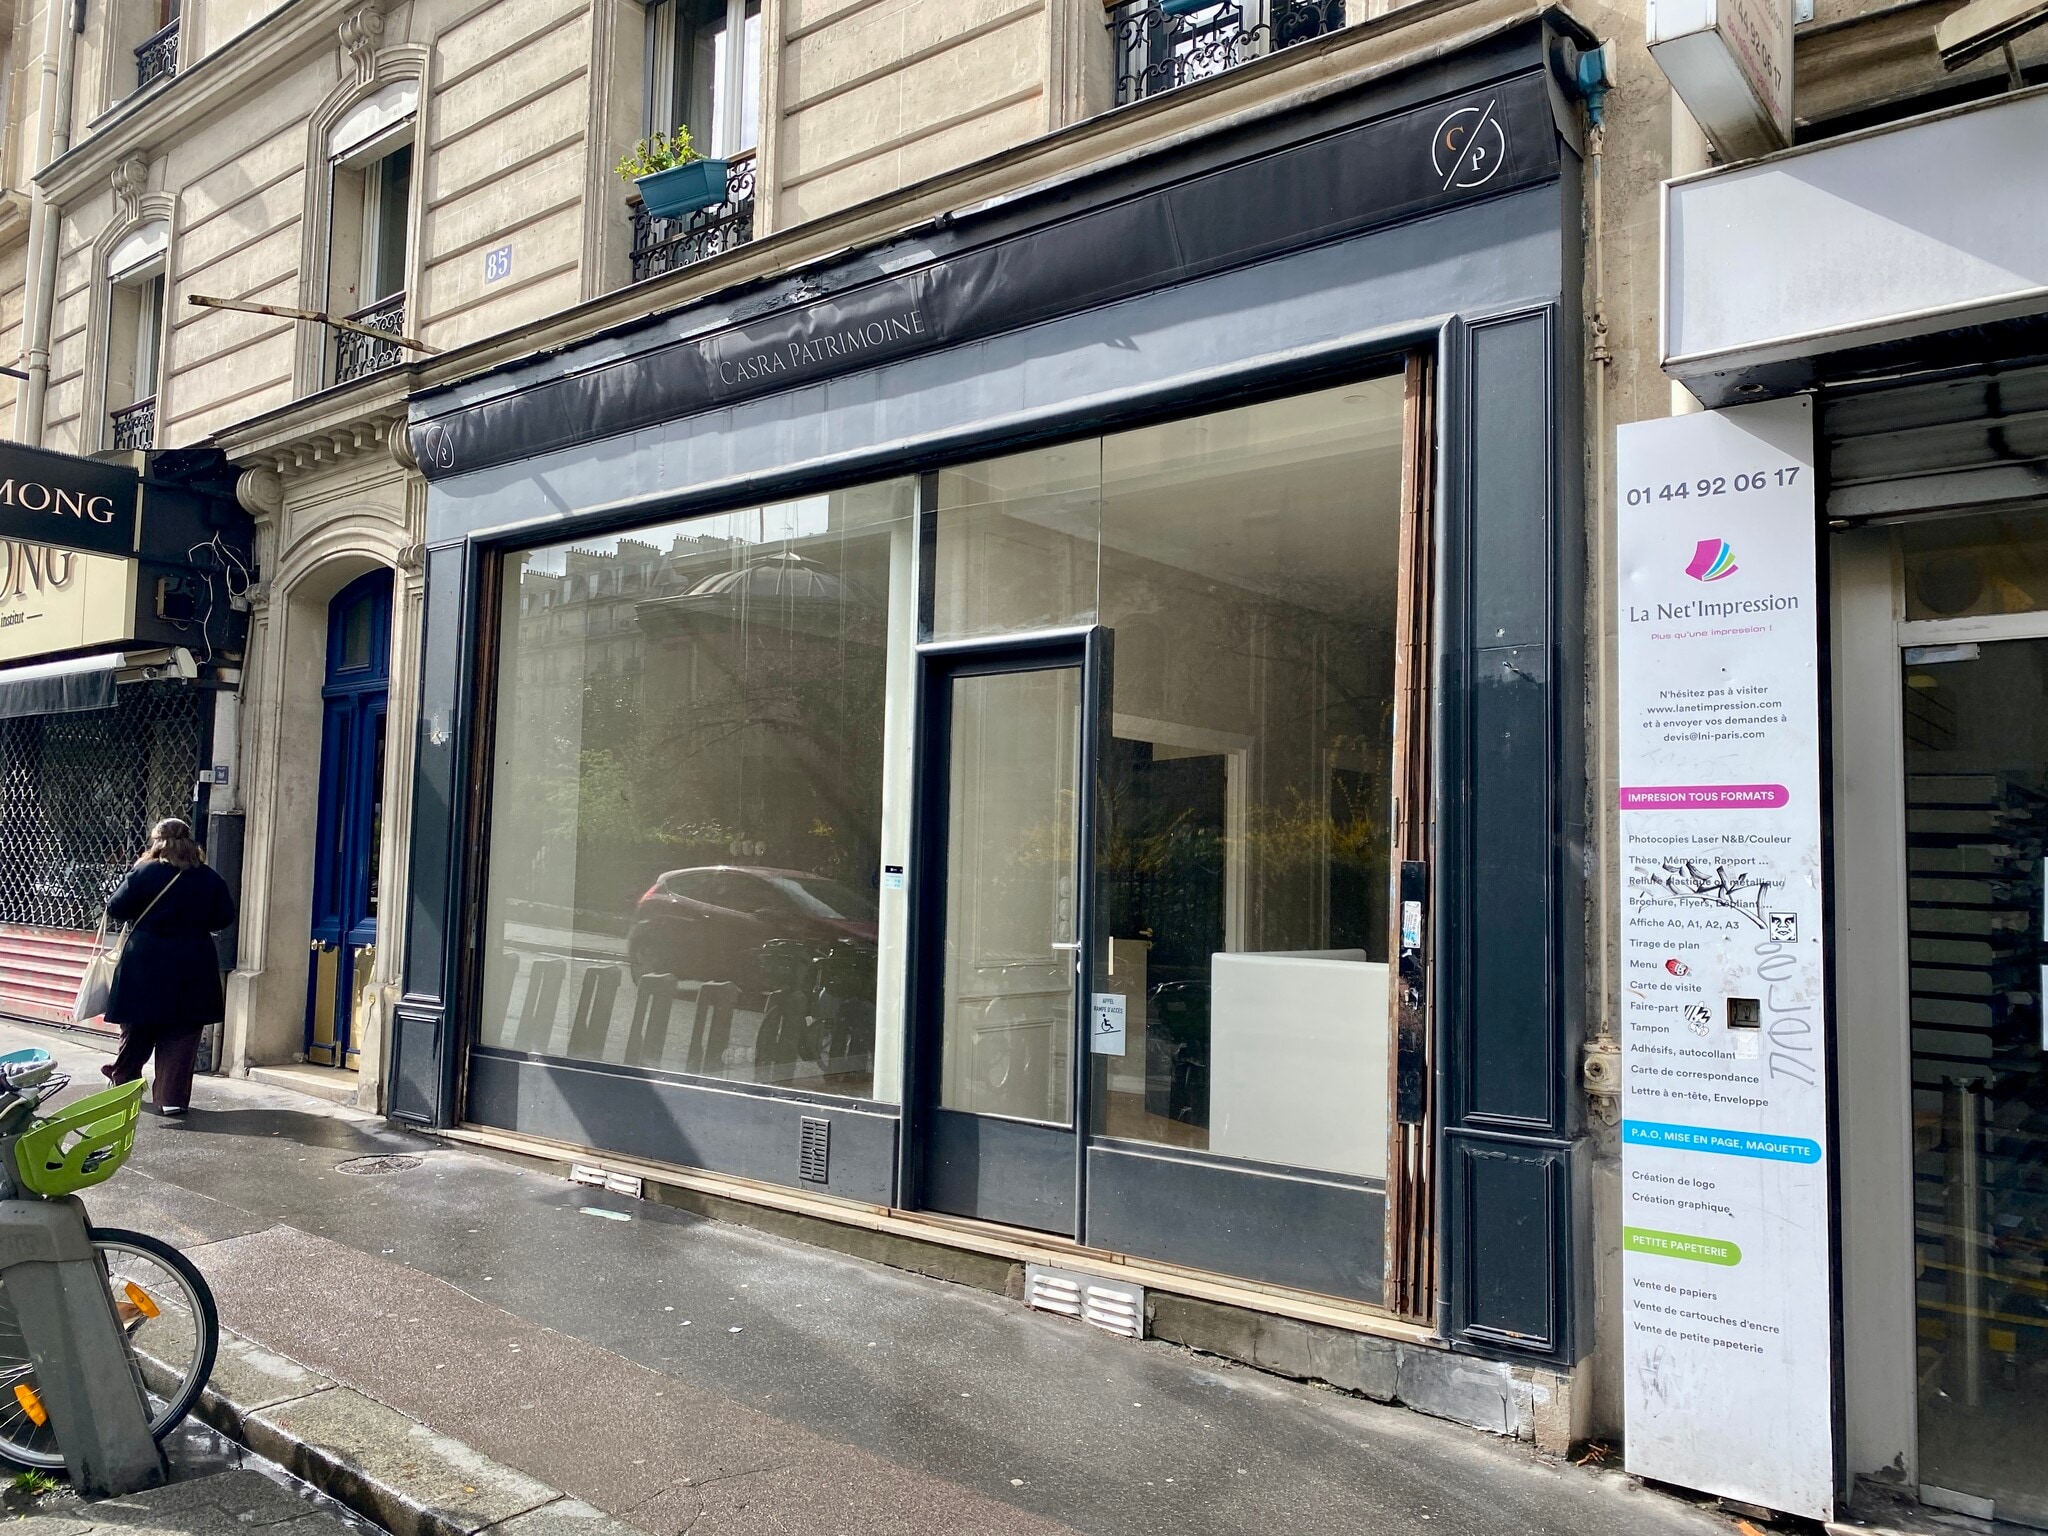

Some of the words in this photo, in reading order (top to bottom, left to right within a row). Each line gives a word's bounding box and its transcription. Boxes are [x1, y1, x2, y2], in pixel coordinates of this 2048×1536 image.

[1750, 22, 1760, 56] 92
[1762, 44, 1772, 77] 06
[1774, 66, 1782, 91] 17
[487, 247, 509, 279] 85
[719, 351, 787, 386] CASRA
[788, 310, 925, 367] PATRIMOINE
[1626, 487, 1650, 506] 01
[1658, 482, 1690, 501] 44
[1696, 476, 1726, 497] 92
[1734, 471, 1766, 492] 06
[1774, 466, 1800, 486] 17
[1630, 606, 1650, 622] La
[1657, 594, 1799, 620] Net'Impression
[1674, 630, 1708, 640] qu'une
[1711, 625, 1766, 636] impression
[1660, 690, 1704, 699] N'hésitez
[1708, 688, 1725, 698] pas
[1728, 686, 1734, 696] à
[1736, 686, 1768, 694] visiter
[1647, 700, 1782, 714] www.lanetimpression.com
[1642, 720, 1652, 728] et
[1655, 718, 1661, 728] à
[1663, 718, 1702, 728] envoyer
[1705, 718, 1722, 726] vos
[1724, 714, 1778, 726] demandes
[1781, 713, 1788, 723] à
[1664, 730, 1765, 742] devis@lni-paris.com
[1628, 793, 1686, 802] IMPRESION
[1689, 792, 1718, 802] TOUS
[1720, 791, 1775, 800] FORMATS
[1628, 835, 1689, 846] Photocopies
[1692, 834, 1718, 844] Laser
[1722, 834, 1792, 844] N&B/Couleur
[1628, 856, 1660, 865] Thèse,
[1664, 856, 1712, 866] Mémoire,
[1630, 898, 1676, 907] Brochure,
[1680, 899, 1712, 908] Flyers,
[1630, 918, 1664, 928] Affiche
[1688, 920, 1702, 930] A1,
[1705, 921, 1722, 930] A2,
[1726, 921, 1740, 930] A3
[1630, 939, 1660, 950] Tirage
[1662, 940, 1676, 949] de
[1678, 941, 1700, 950] plan
[1630, 960, 1658, 970] Menu
[1630, 981, 1658, 991] Carte
[1660, 983, 1672, 992] de
[1675, 984, 1702, 993] visite
[1630, 1002, 1679, 1013] Faire-part
[1630, 1023, 1670, 1034] Tampon
[1630, 1044, 1676, 1056] Adhésifs,
[1631, 1064, 1659, 1076] Carte
[1662, 1068, 1674, 1076] de
[1676, 1069, 1760, 1084] correspondance
[1631, 1086, 1661, 1096] Lettre
[1663, 1088, 1670, 1098] à
[1672, 1090, 1711, 1102] en-tête,
[1714, 1093, 1769, 1107] Enveloppe
[1632, 1128, 1662, 1140] P.A.O,
[1664, 1131, 1690, 1142] MISE
[1694, 1134, 1708, 1144] EN
[1711, 1136, 1742, 1150] PAGE,
[1746, 1140, 1810, 1156] MAQUETTE
[1632, 1170, 1675, 1184] Création
[1678, 1176, 1690, 1186] de
[1693, 1178, 1716, 1190] logo
[1632, 1192, 1675, 1206] Création
[1678, 1199, 1730, 1214] graphique
[1632, 1235, 1668, 1248] PETITE
[1670, 1240, 1728, 1258] PAPETERIE
[1633, 1278, 1662, 1291] Vente
[1664, 1284, 1677, 1294] de
[1680, 1288, 1718, 1300] papiers
[1633, 1300, 1662, 1313] Vente
[1664, 1306, 1677, 1316] de
[1680, 1308, 1738, 1327] cartouches
[1740, 1320, 1780, 1334] d'encre
[1634, 1321, 1662, 1335] Vente
[1665, 1327, 1678, 1338] de
[1680, 1330, 1710, 1344] petite
[1713, 1337, 1764, 1354] papeterie
